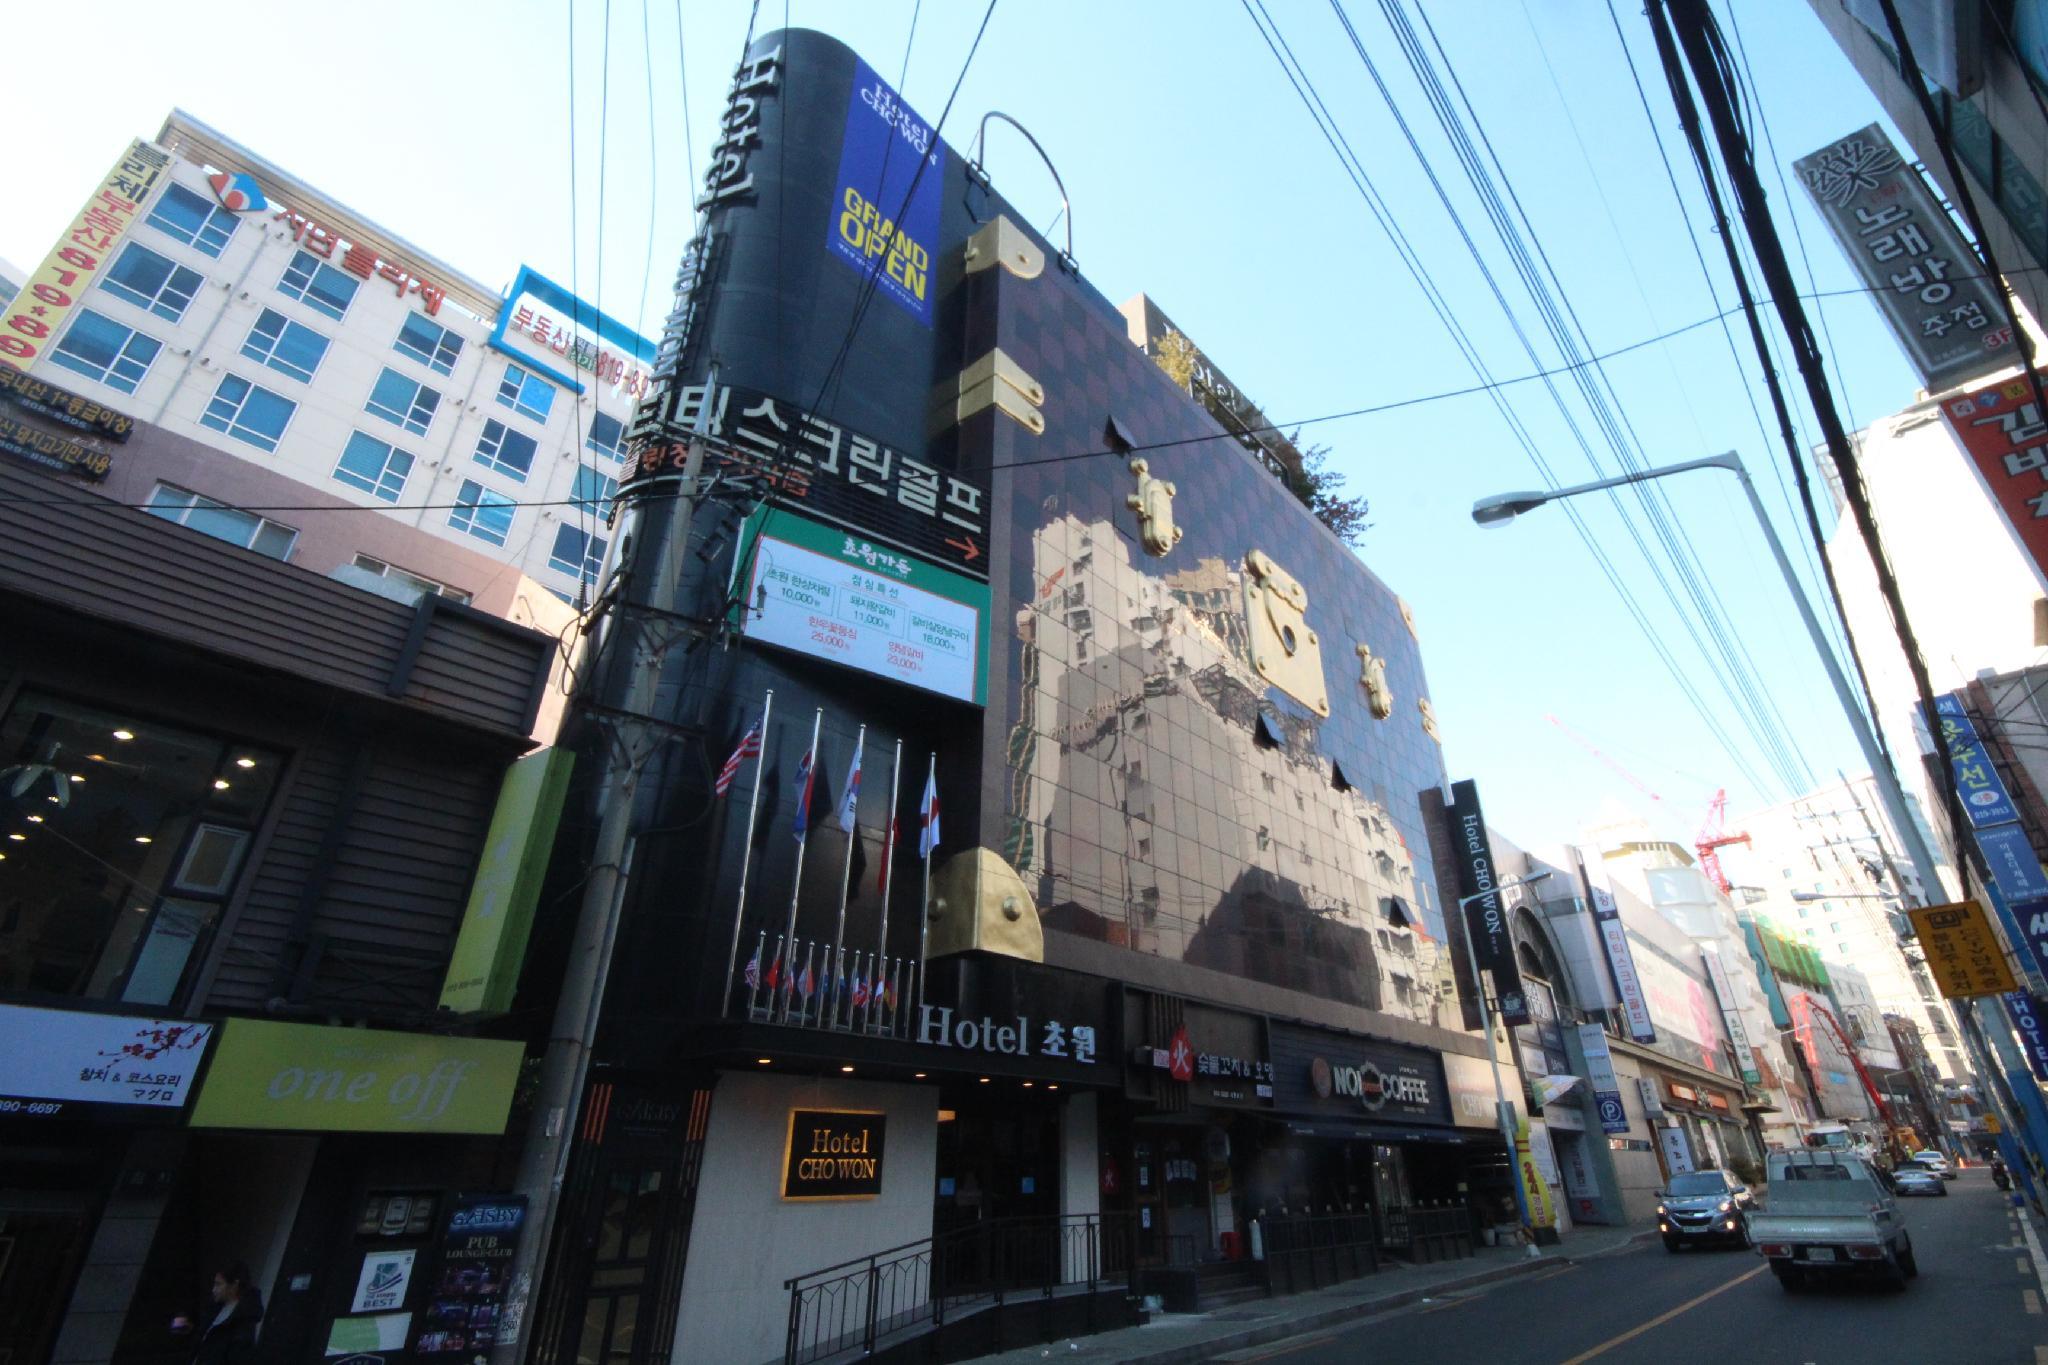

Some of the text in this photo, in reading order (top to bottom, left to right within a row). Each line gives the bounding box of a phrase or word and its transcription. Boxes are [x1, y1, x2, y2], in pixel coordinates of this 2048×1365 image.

[861, 88, 897, 127] CHO
[874, 82, 928, 144] Hotel
[695, 44, 781, 213] Hotel
[71, 190, 137, 254] 부동산
[273, 207, 338, 260] 서면
[843, 187, 928, 272] GRAND
[839, 210, 927, 301] OPEN
[1856, 205, 1952, 304] 노래방
[514, 305, 571, 355] 부동산
[1921, 302, 1987, 337] 주점
[1983, 328, 2013, 351] 3F
[842, 538, 912, 573] 초원가든
[1463, 814, 1502, 935] Hotel CHO WON
[916, 1003, 1030, 1057] Hotel
[1041, 1020, 1096, 1063] 초원
[1173, 1040, 1191, 1073] 火
[80, 1067, 108, 1082] 참치
[126, 1072, 182, 1087] 코스요리
[132, 1089, 175, 1101] マグロ
[267, 1058, 481, 1122] one off
[1380, 1073, 1430, 1103] COFFEE
[811, 1129, 869, 1153] Hotel
[799, 1158, 877, 1180] CHO WON
[450, 1207, 521, 1227] GATSBY
[467, 1236, 498, 1249] PUB
[363, 1298, 398, 1309] BEST
